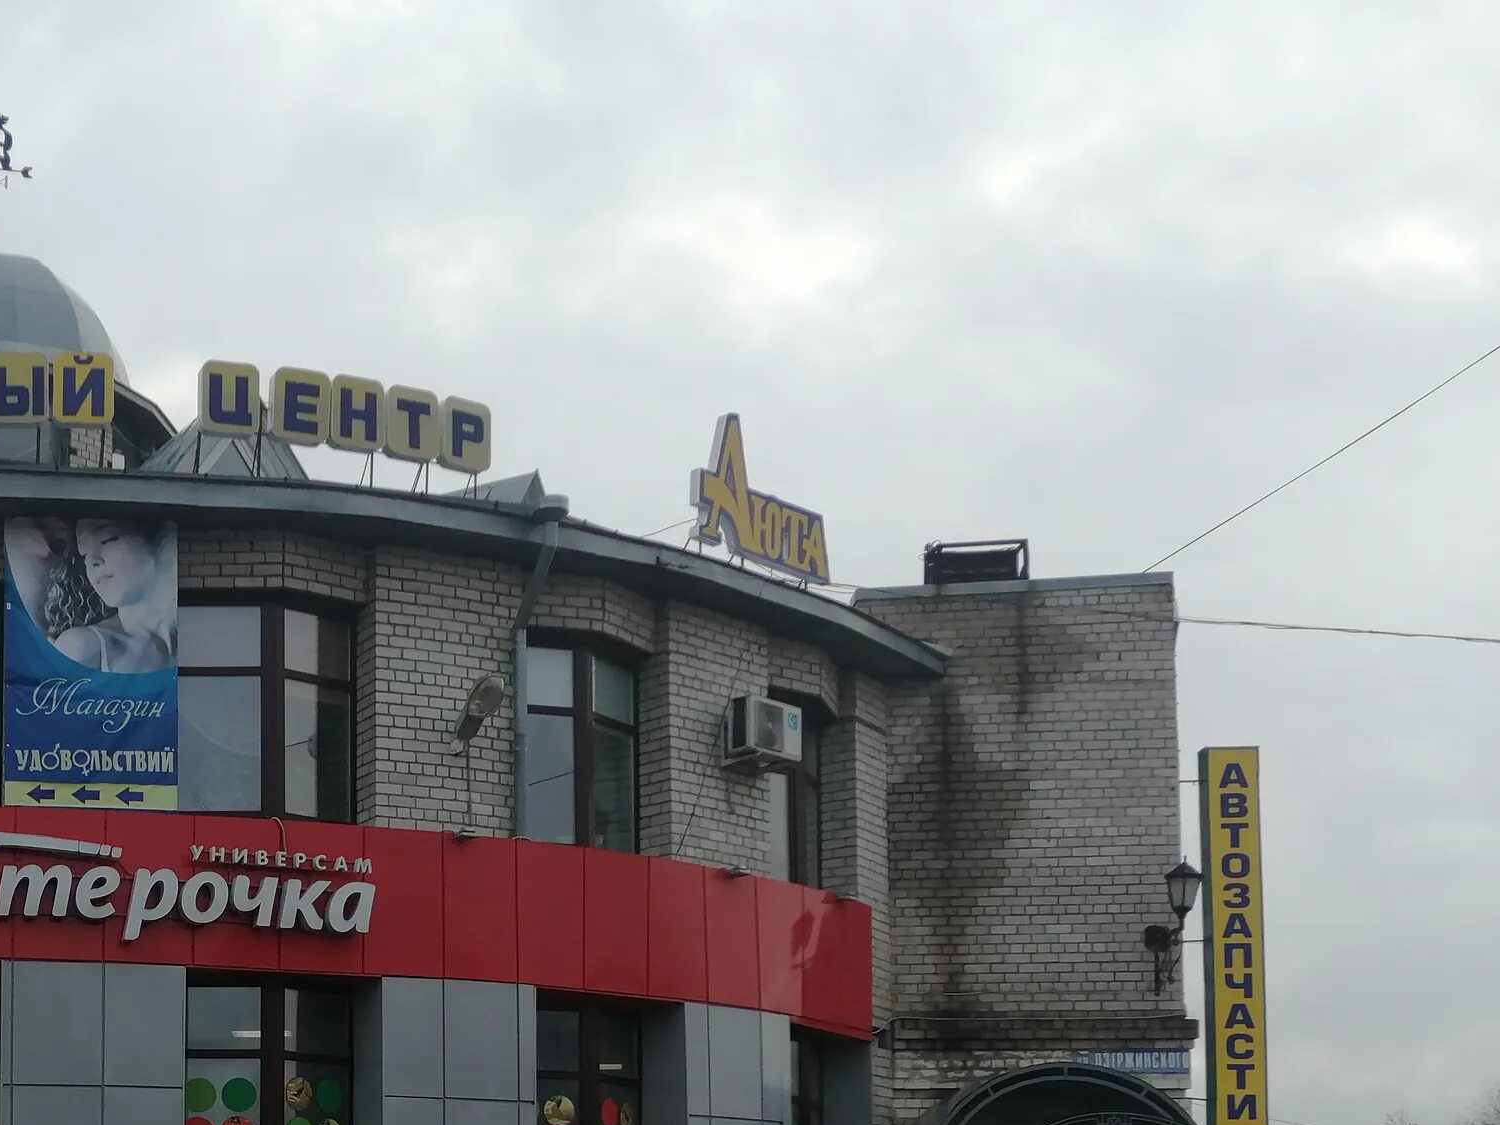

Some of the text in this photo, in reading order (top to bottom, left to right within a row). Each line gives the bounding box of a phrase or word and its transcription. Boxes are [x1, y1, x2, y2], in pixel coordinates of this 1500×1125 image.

[207, 373, 487, 459] ЦЕНТР
[15, 677, 166, 734] Магазин
[15, 743, 174, 777] УДОВОЛЬСТВИЙ
[190, 845, 373, 875] УНИВЕРСАМ
[1218, 762, 1257, 1120] АВТОЗАПЧАСТИ
